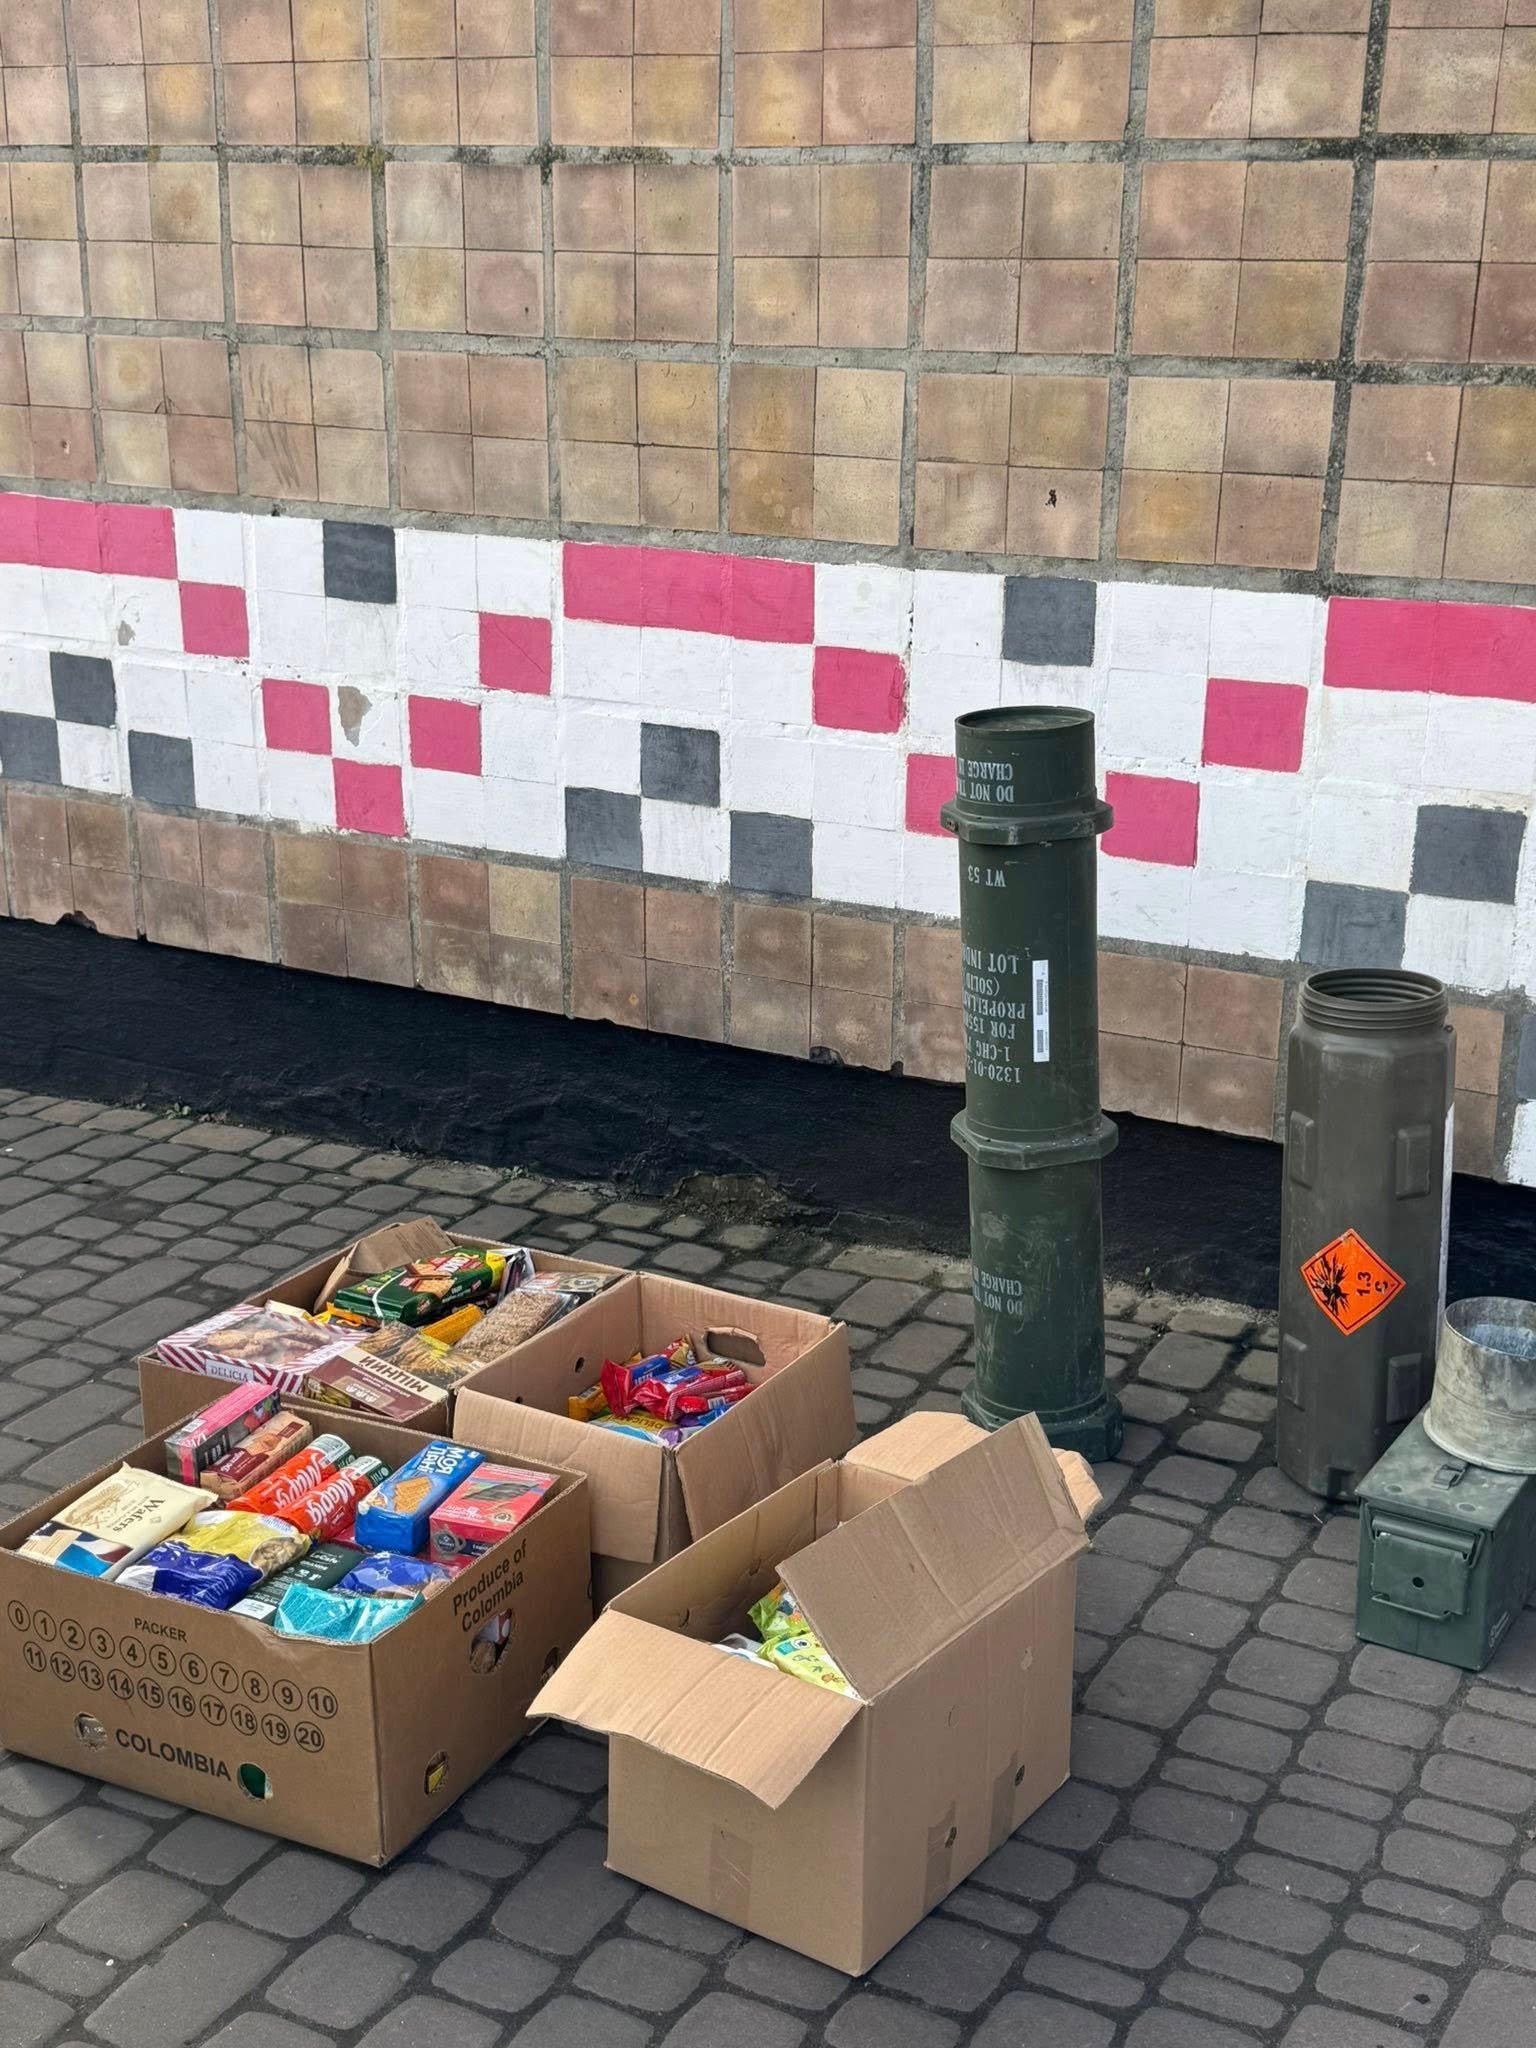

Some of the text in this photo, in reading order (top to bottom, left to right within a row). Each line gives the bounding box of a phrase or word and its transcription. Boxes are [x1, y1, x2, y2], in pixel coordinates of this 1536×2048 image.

[967, 760, 1014, 781] CHARGE
[970, 782, 990, 801] NOT
[997, 785, 1015, 802] DO
[968, 865, 1007, 887] WT 53
[988, 953, 1019, 974] LOT
[991, 1020, 1015, 1039] FOR
[976, 1040, 1010, 1062] 1-CHG
[981, 1271, 1022, 1297] CHARGE
[1357, 1271, 1371, 1296] 1.3
[984, 1291, 1002, 1312] NOT
[1007, 1299, 1023, 1315] DO
[210, 1365, 250, 1382] DELICIA
[359, 1355, 430, 1394] МІЦНИЙ
[417, 1446, 438, 1474] ПАНІ
[435, 1446, 465, 1475] МОЯ
[274, 1453, 322, 1508] Марія
[306, 1471, 356, 1525] Марія
[113, 1498, 167, 1532] Wafers
[453, 1539, 527, 1616] Produce of
[462, 1570, 524, 1632] Colombia
[134, 1617, 188, 1643] PACKER
[15, 1607, 334, 1715] 0 1 2 3 4 5 6 7 8 9 10
[27, 1647, 321, 1747] 11 12 13 14 15 16 17 18 19 20
[115, 1728, 232, 1782] COLOMBIA
